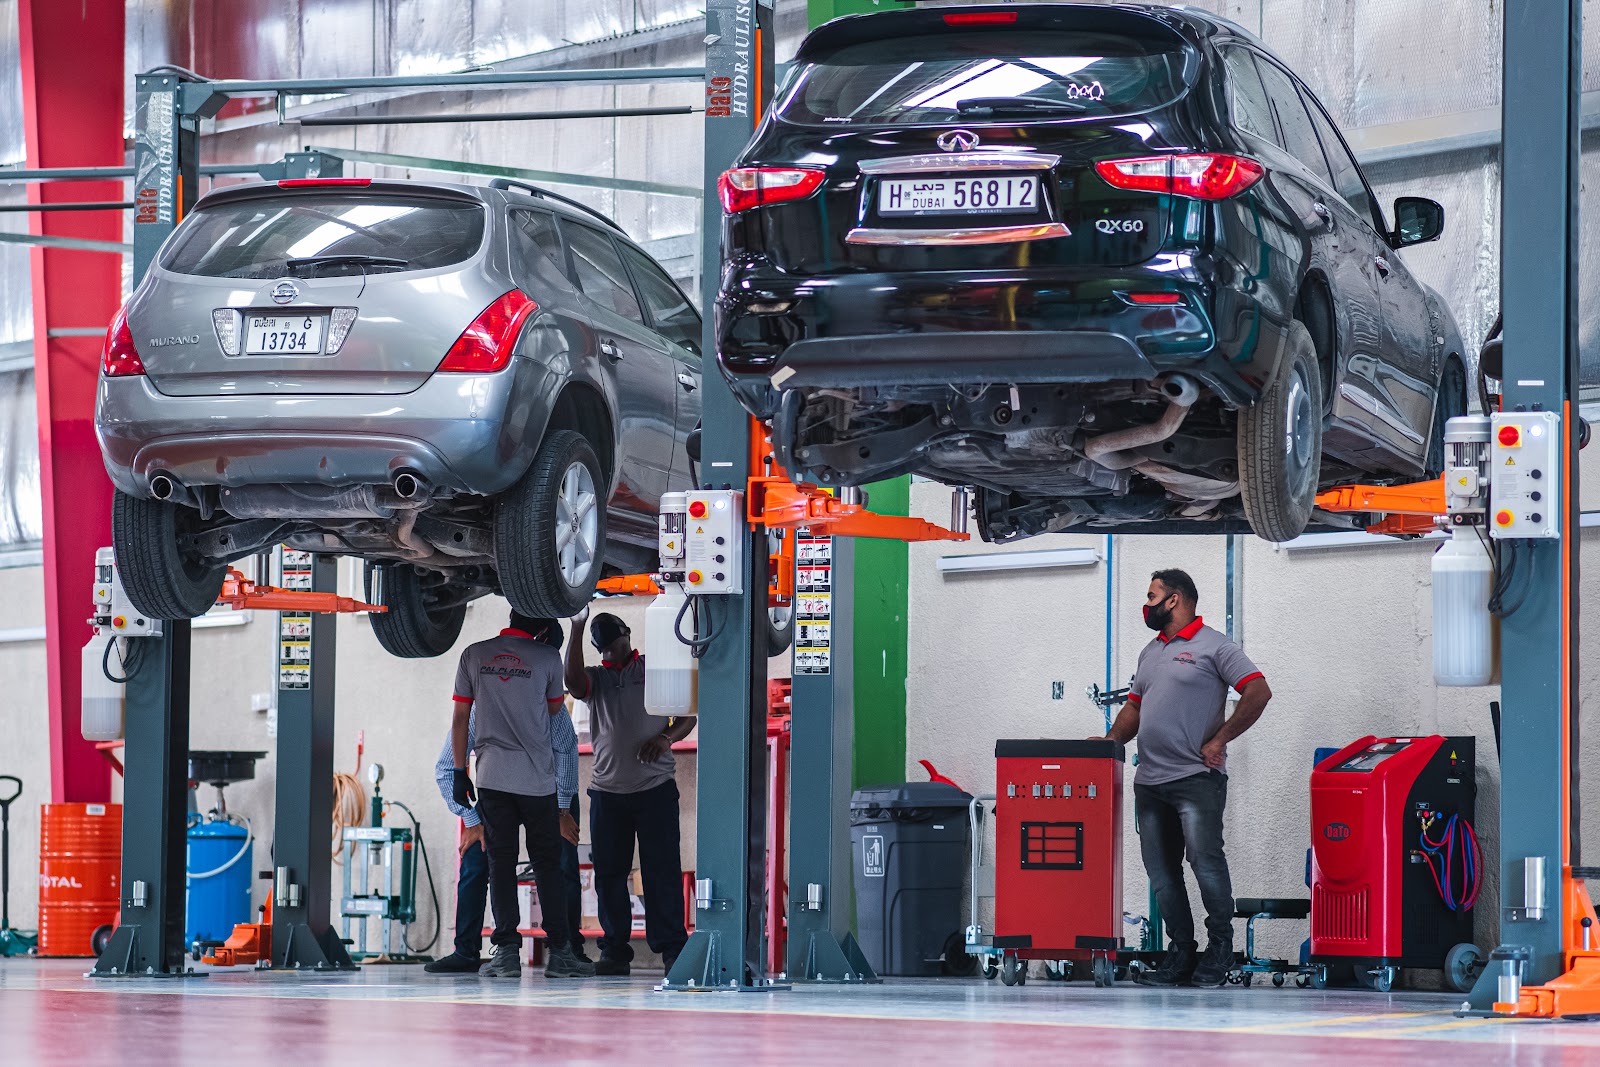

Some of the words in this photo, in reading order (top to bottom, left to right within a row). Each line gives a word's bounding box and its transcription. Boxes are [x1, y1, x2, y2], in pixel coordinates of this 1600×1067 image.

[890, 184, 902, 208] H
[954, 179, 1033, 207] 56812
[913, 198, 945, 208] DUBAI
[1095, 219, 1144, 234] QX60
[303, 319, 313, 330] G
[149, 334, 200, 347] MURANO
[261, 331, 307, 351] 13734
[499, 667, 532, 675] PLATINA
[1327, 826, 1349, 837] DaTo
